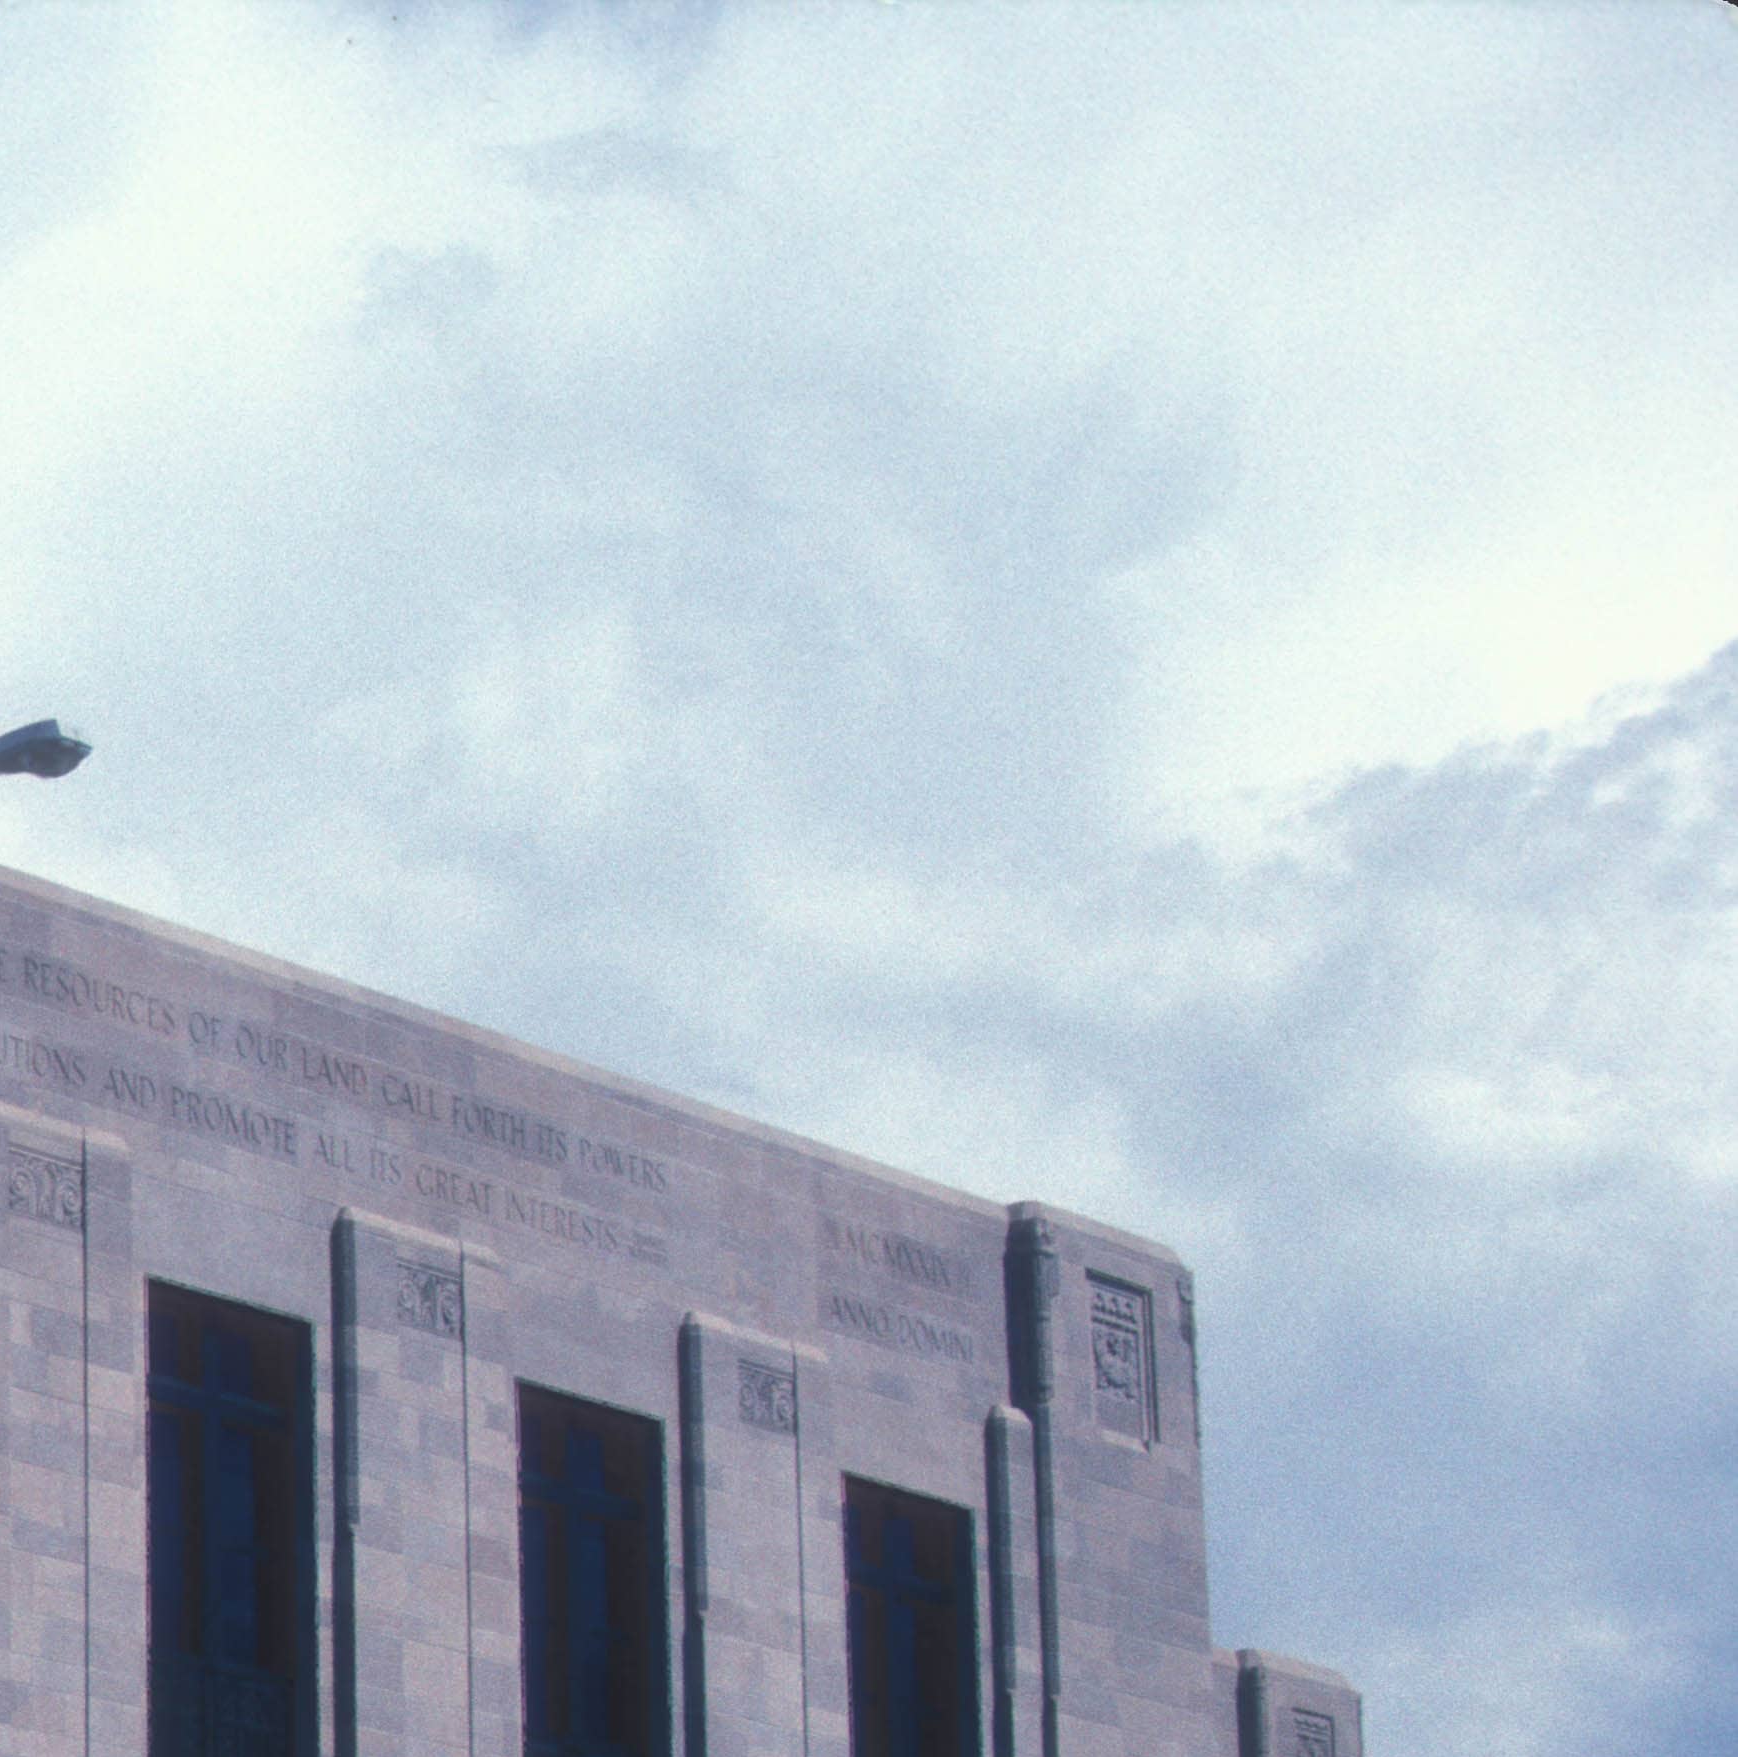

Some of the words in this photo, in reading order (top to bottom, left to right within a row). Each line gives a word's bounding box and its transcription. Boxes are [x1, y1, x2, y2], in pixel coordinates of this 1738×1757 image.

[24, 955, 175, 1037] RESOURCES
[188, 1010, 223, 1047] OF
[236, 1020, 288, 1072] OUR
[302, 1046, 368, 1096] LAND
[381, 1074, 442, 1124] CALL
[451, 1096, 525, 1150] FORTH
[537, 1123, 569, 1163] ITS
[580, 1138, 668, 1193] POWERS
[104, 1069, 156, 1106] AND
[170, 1085, 296, 1156] PROMOTE
[313, 1133, 356, 1174] ALL
[370, 1147, 403, 1186] ITS
[415, 1164, 493, 1216] GREAT
[506, 1194, 619, 1250] INTERESTS
[830, 1294, 889, 1337] ANNO
[898, 1314, 975, 1363] DOMINI
